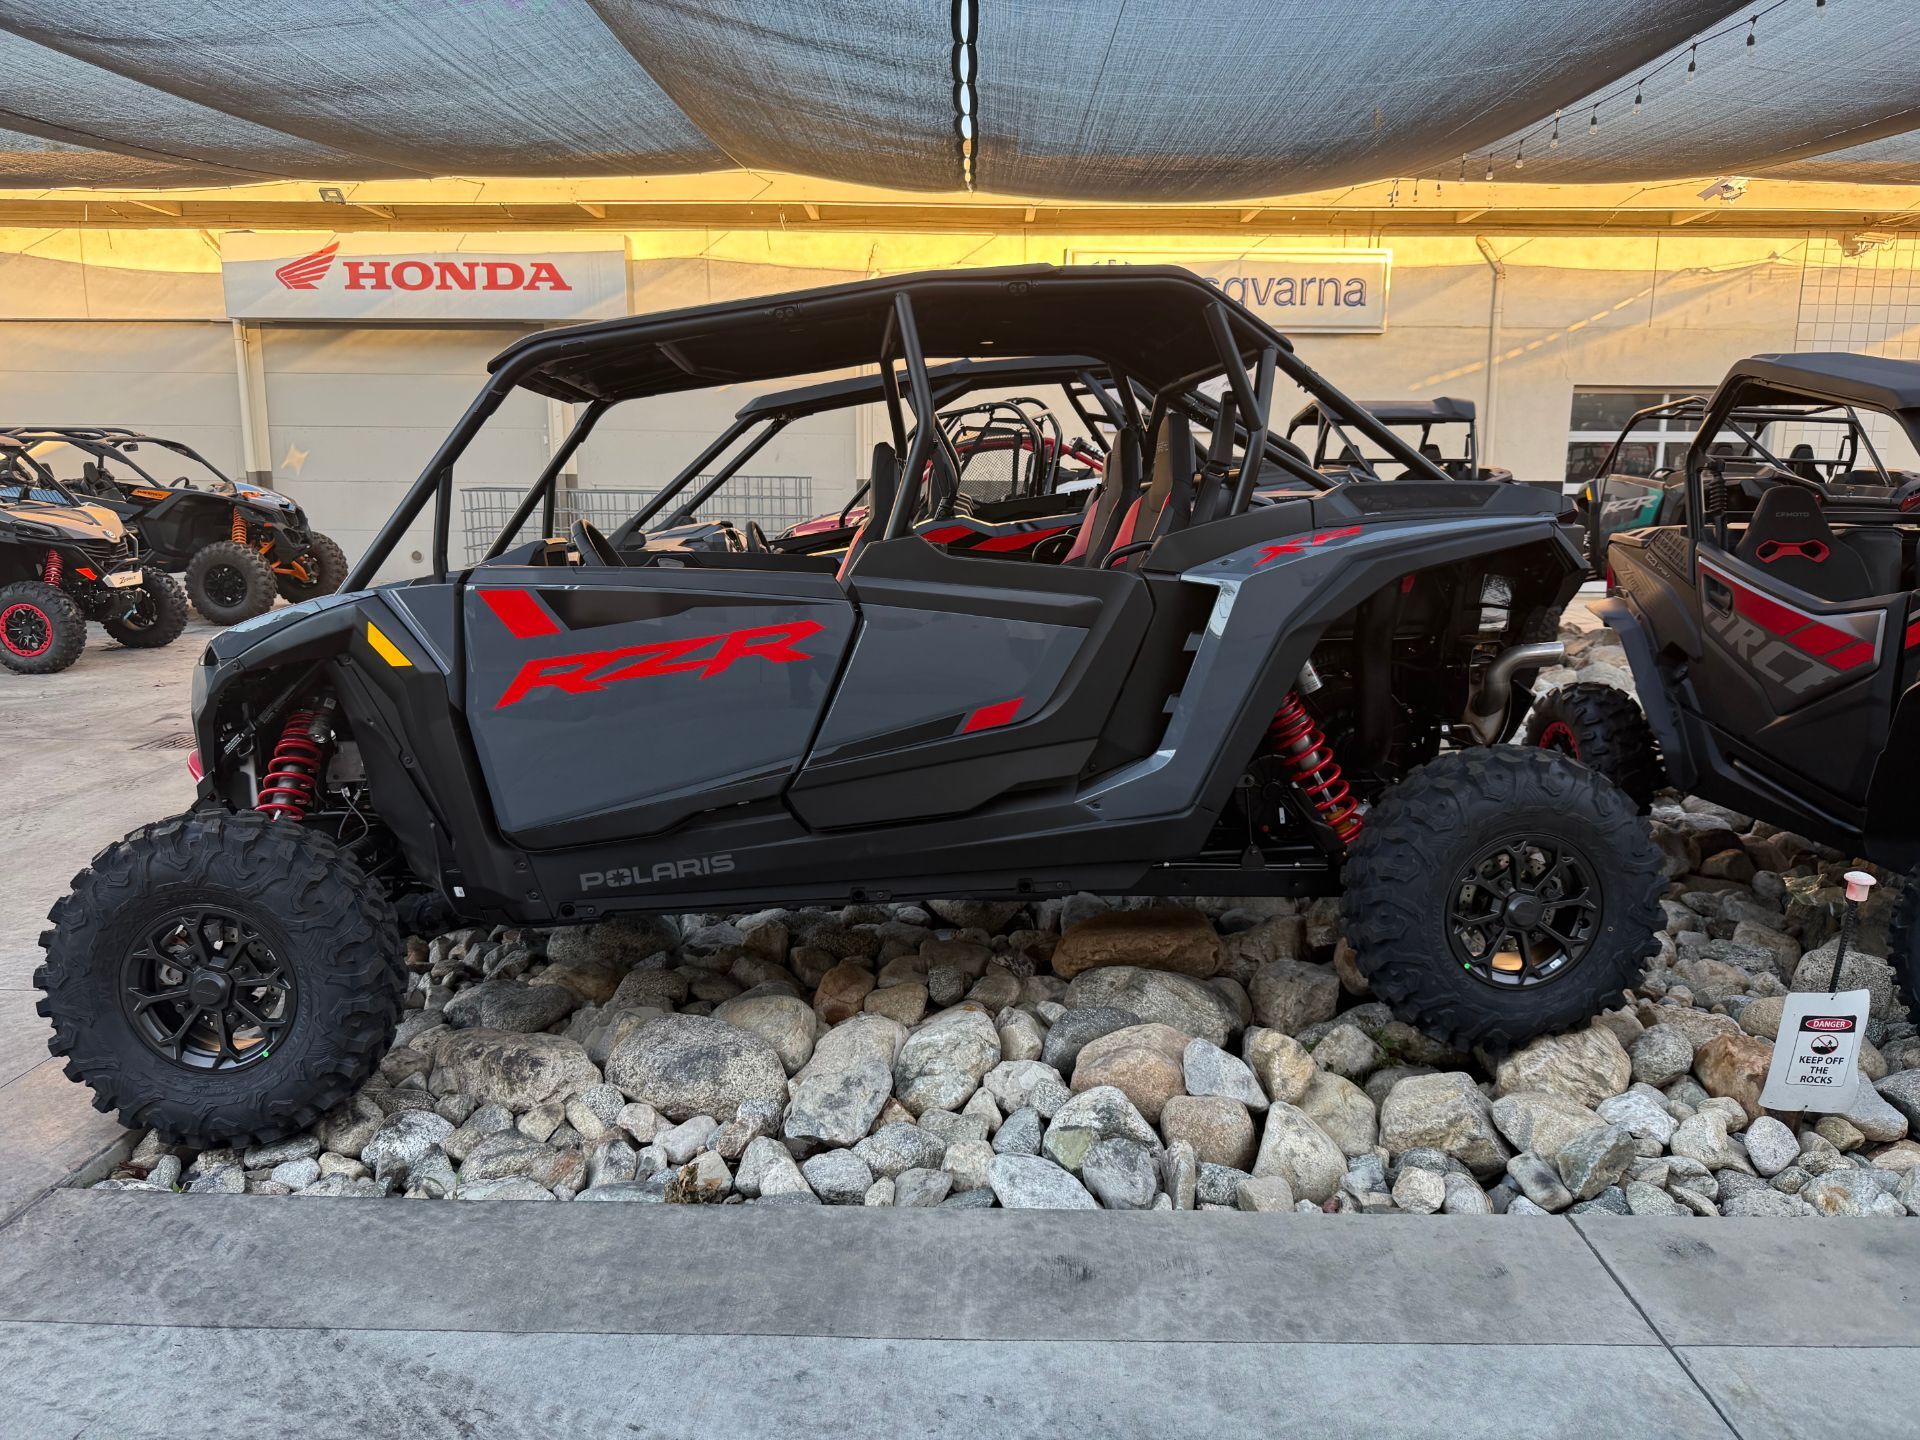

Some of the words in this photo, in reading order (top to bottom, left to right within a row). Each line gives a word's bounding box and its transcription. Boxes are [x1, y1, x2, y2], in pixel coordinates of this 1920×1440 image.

[342, 261, 573, 291] HONDA
[1603, 495, 1657, 515] RZR
[493, 619, 826, 711] RZR
[579, 853, 736, 892] POLARIS
[1813, 1020, 1846, 1028] DANGER
[1799, 1056, 1823, 1064] KEEP
[1825, 1057, 1844, 1065] OFF
[1810, 1066, 1828, 1075] THE
[1800, 1075, 1832, 1084] ROCKS
